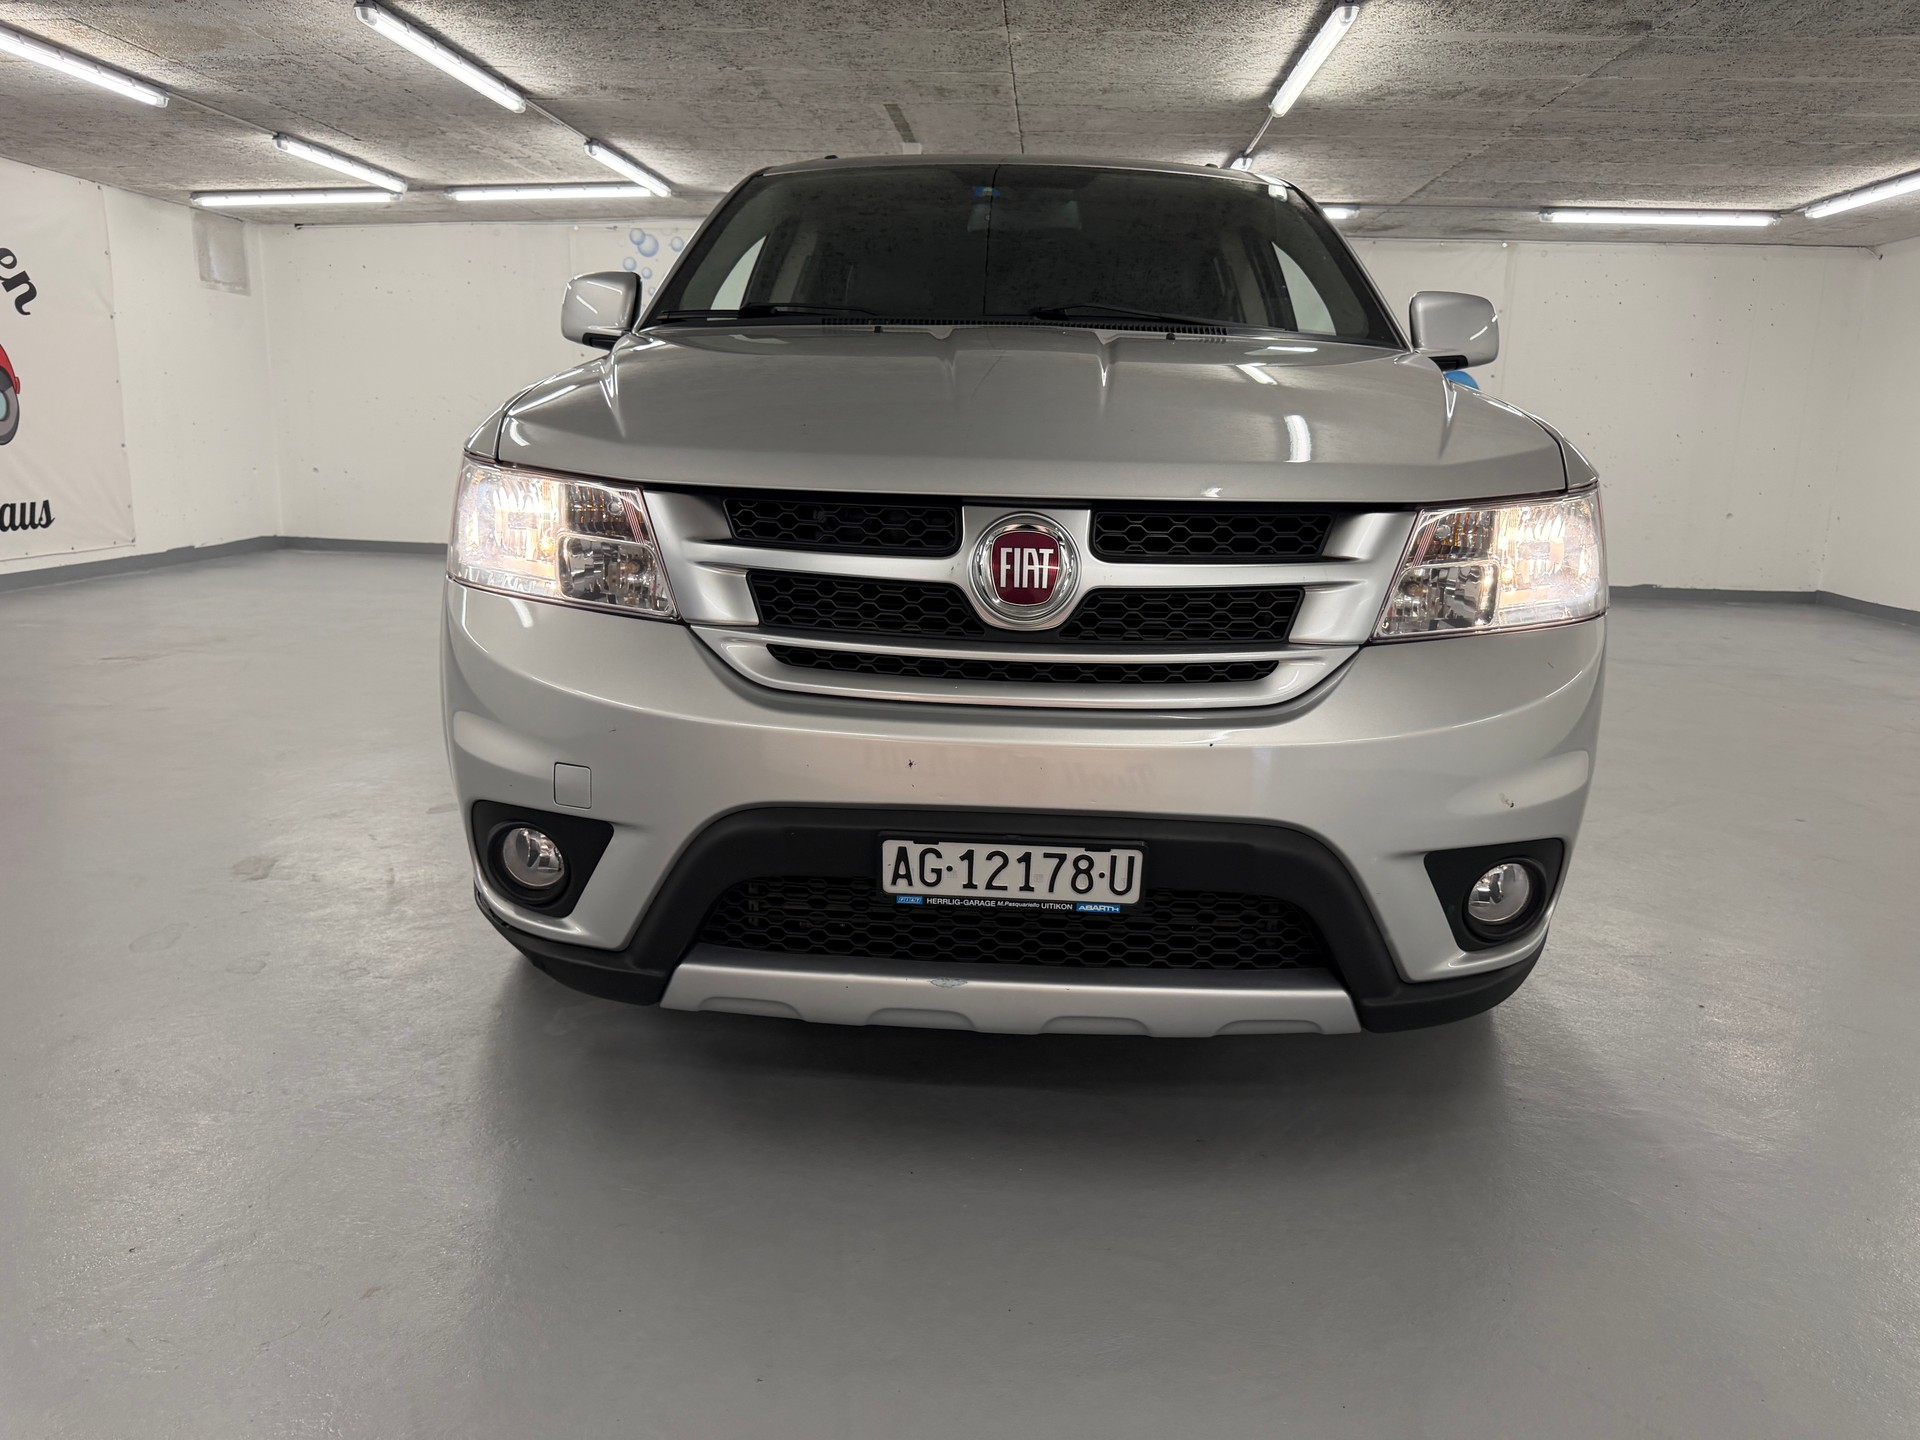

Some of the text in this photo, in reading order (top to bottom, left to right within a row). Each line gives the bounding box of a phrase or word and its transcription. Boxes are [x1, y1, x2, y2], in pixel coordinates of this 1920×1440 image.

[0, 499, 56, 532] aus
[1000, 547, 1054, 589] FIAT
[926, 897, 996, 907] HERRLIG-GARAGE
[1041, 902, 1073, 911] UITIKON
[1078, 904, 1120, 913] ABARTH
